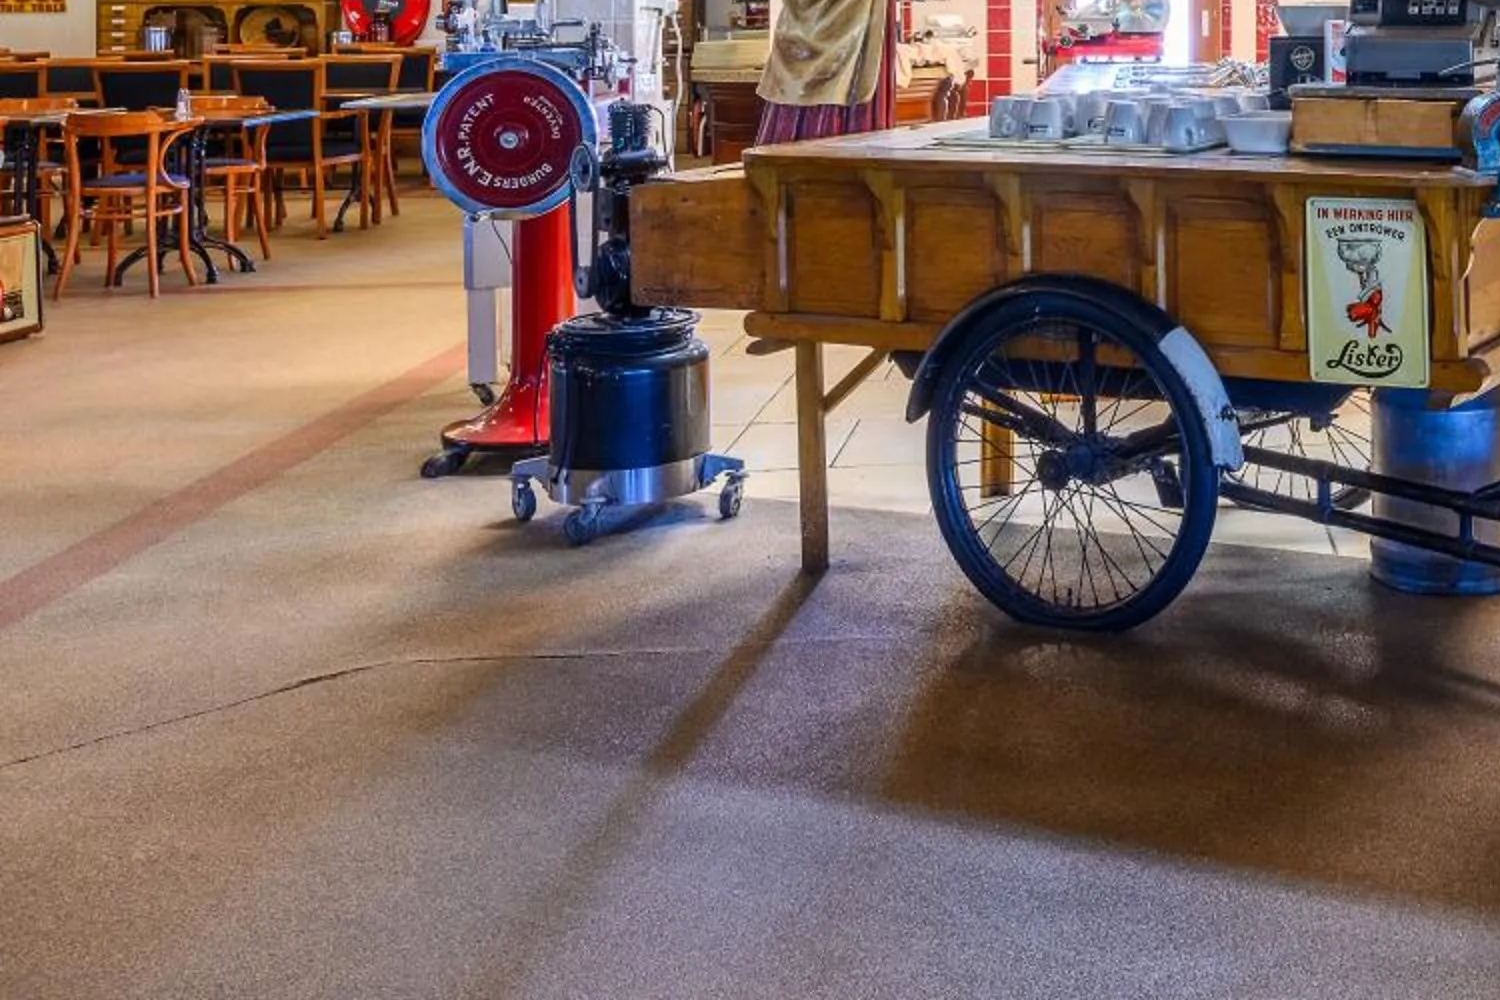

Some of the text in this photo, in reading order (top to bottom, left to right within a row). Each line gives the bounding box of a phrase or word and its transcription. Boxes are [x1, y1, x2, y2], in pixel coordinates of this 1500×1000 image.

[457, 92, 495, 140] PATENT
[1317, 207, 1414, 222] IN WERKING HIER
[1326, 339, 1403, 379] Lister
